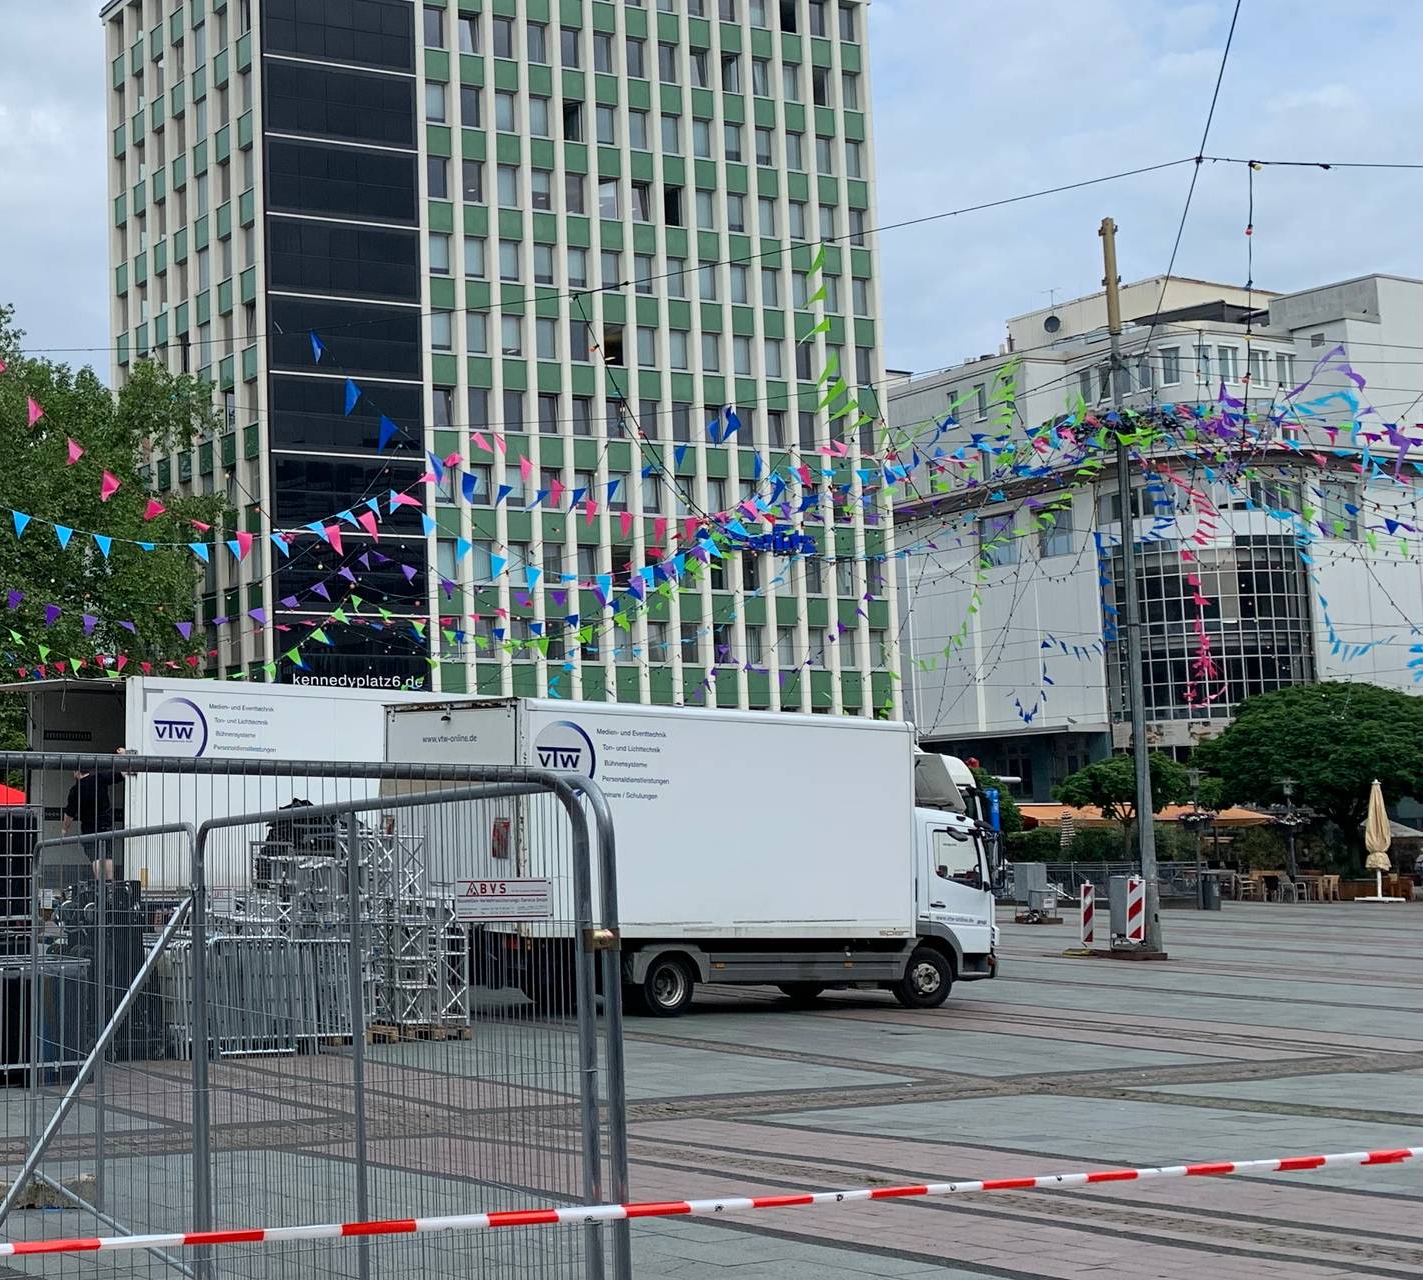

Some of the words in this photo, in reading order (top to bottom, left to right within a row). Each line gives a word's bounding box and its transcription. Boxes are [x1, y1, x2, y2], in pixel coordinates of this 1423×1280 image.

[596, 728, 620, 736] Medien-
[632, 730, 667, 738] Eventtechnik
[422, 734, 478, 744] www.vtw-online.de
[627, 745, 661, 753] Lichttechnik
[604, 760, 648, 768] Bühnensysteme
[602, 775, 670, 786] Personaldienstleistungen
[625, 792, 659, 801] Schulungen
[479, 883, 507, 894] BVS
